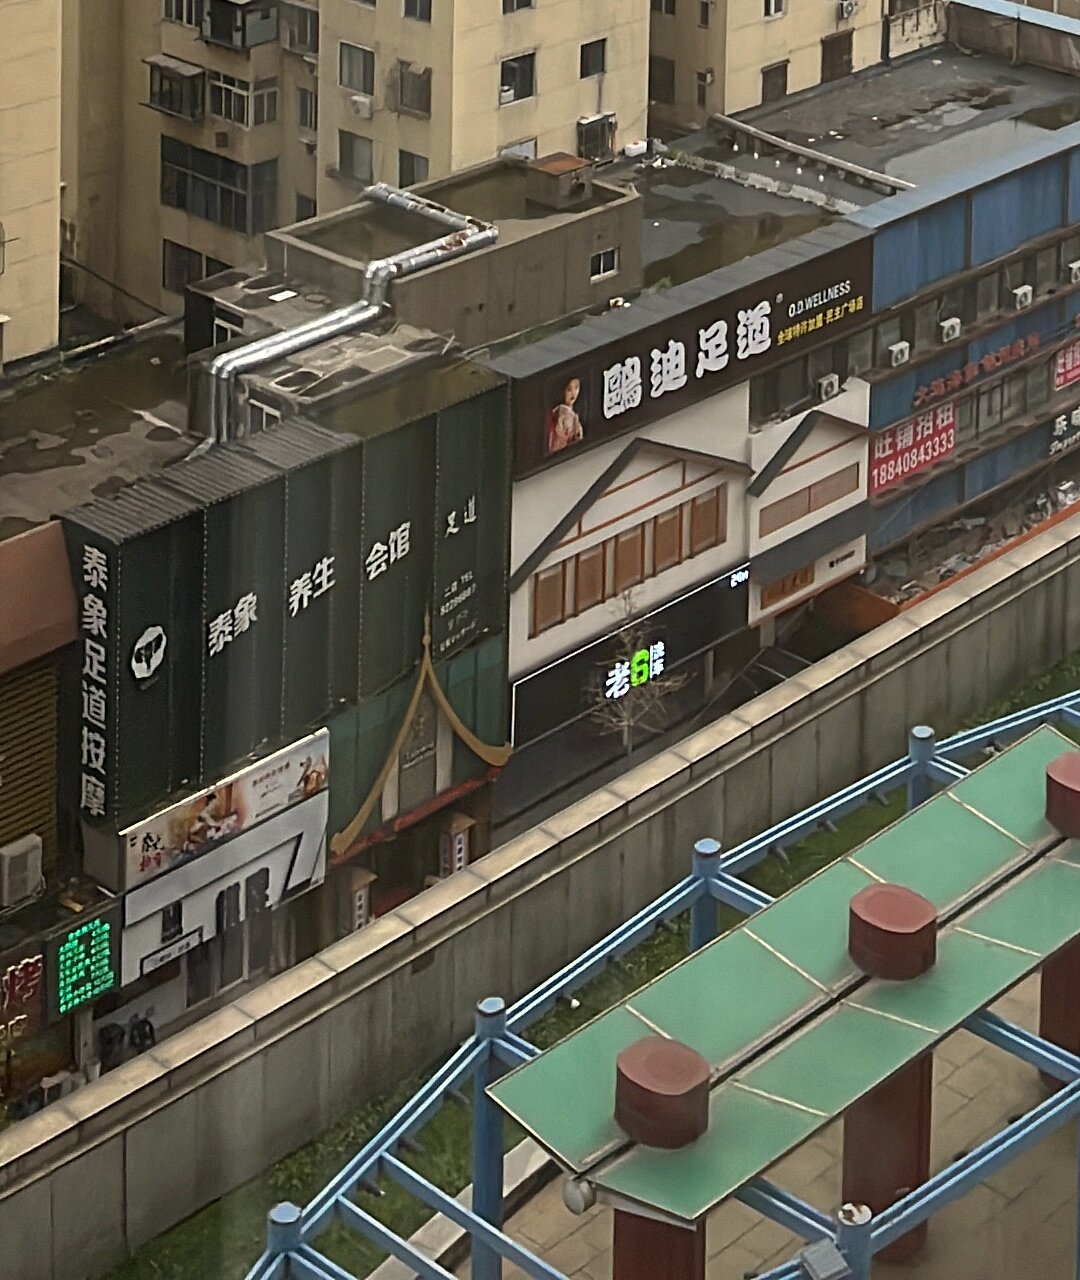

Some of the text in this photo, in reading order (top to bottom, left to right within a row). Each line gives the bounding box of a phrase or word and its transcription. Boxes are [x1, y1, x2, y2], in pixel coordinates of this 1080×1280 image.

[872, 428, 955, 489] 18840843333
[875, 402, 954, 460] 旺铺招租
[208, 591, 258, 657] 泰象
[288, 555, 336, 618] 养生
[365, 520, 411, 581] 会馆
[80, 544, 108, 817] 泰象足道按摩
